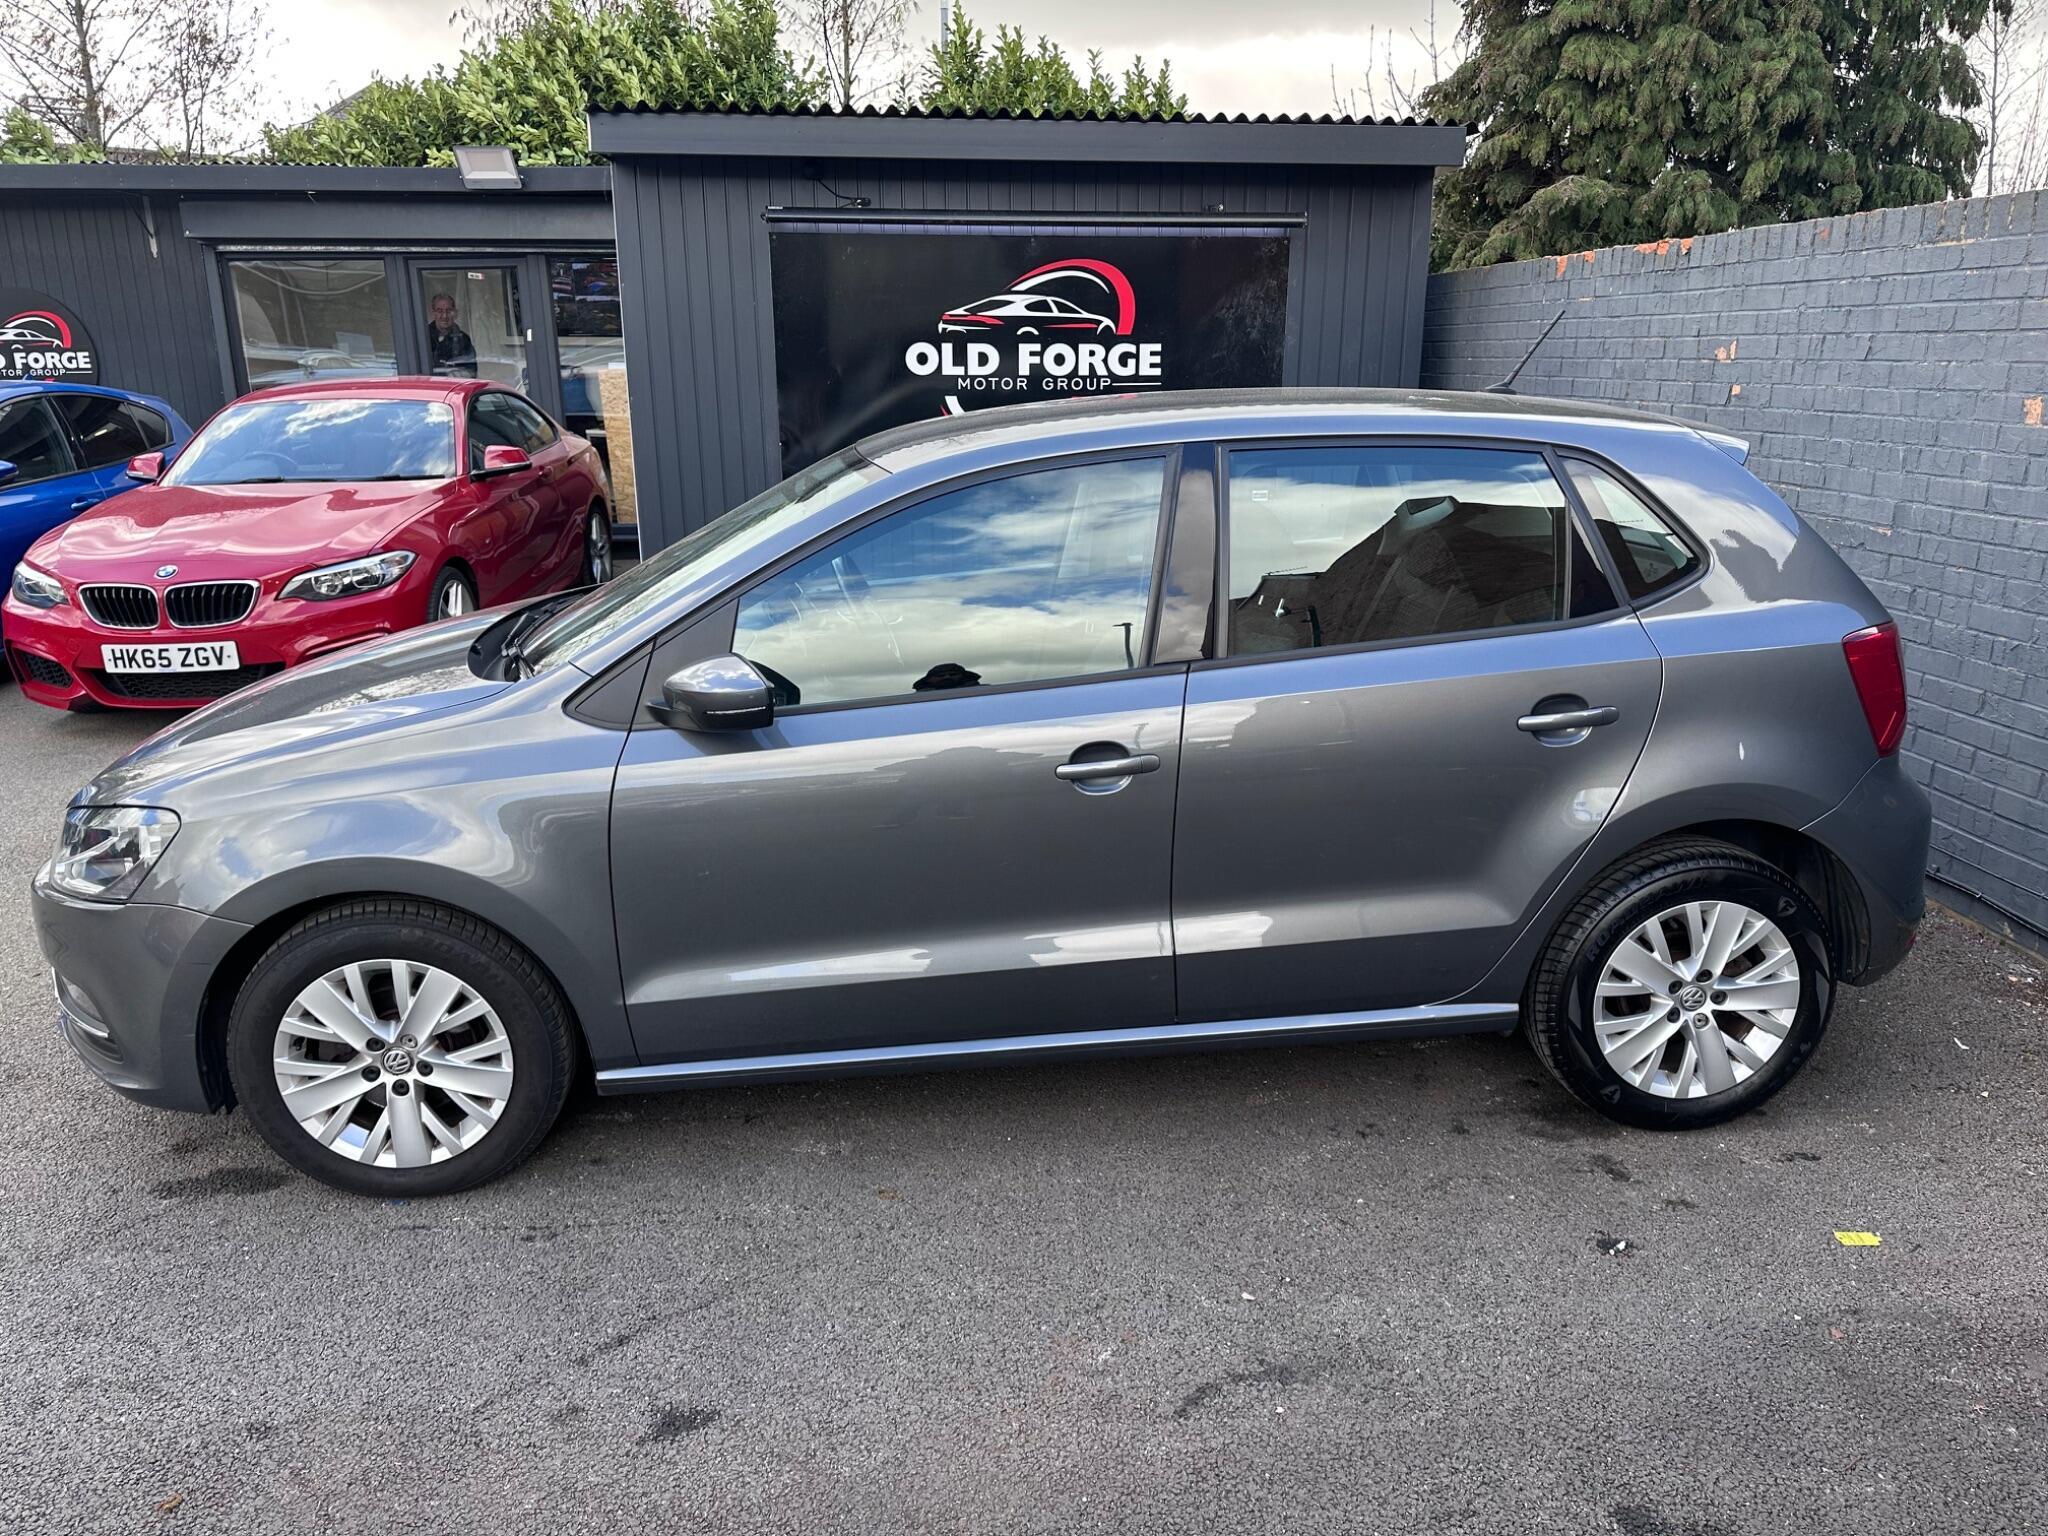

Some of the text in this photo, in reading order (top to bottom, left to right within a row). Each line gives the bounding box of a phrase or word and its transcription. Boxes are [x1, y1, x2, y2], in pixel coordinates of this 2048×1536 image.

[13, 352, 92, 369] FORGE
[905, 341, 1162, 376] OLD FORGE
[958, 377, 1111, 390] MOTOR GROUP
[111, 645, 224, 669] HK65 ZGV
